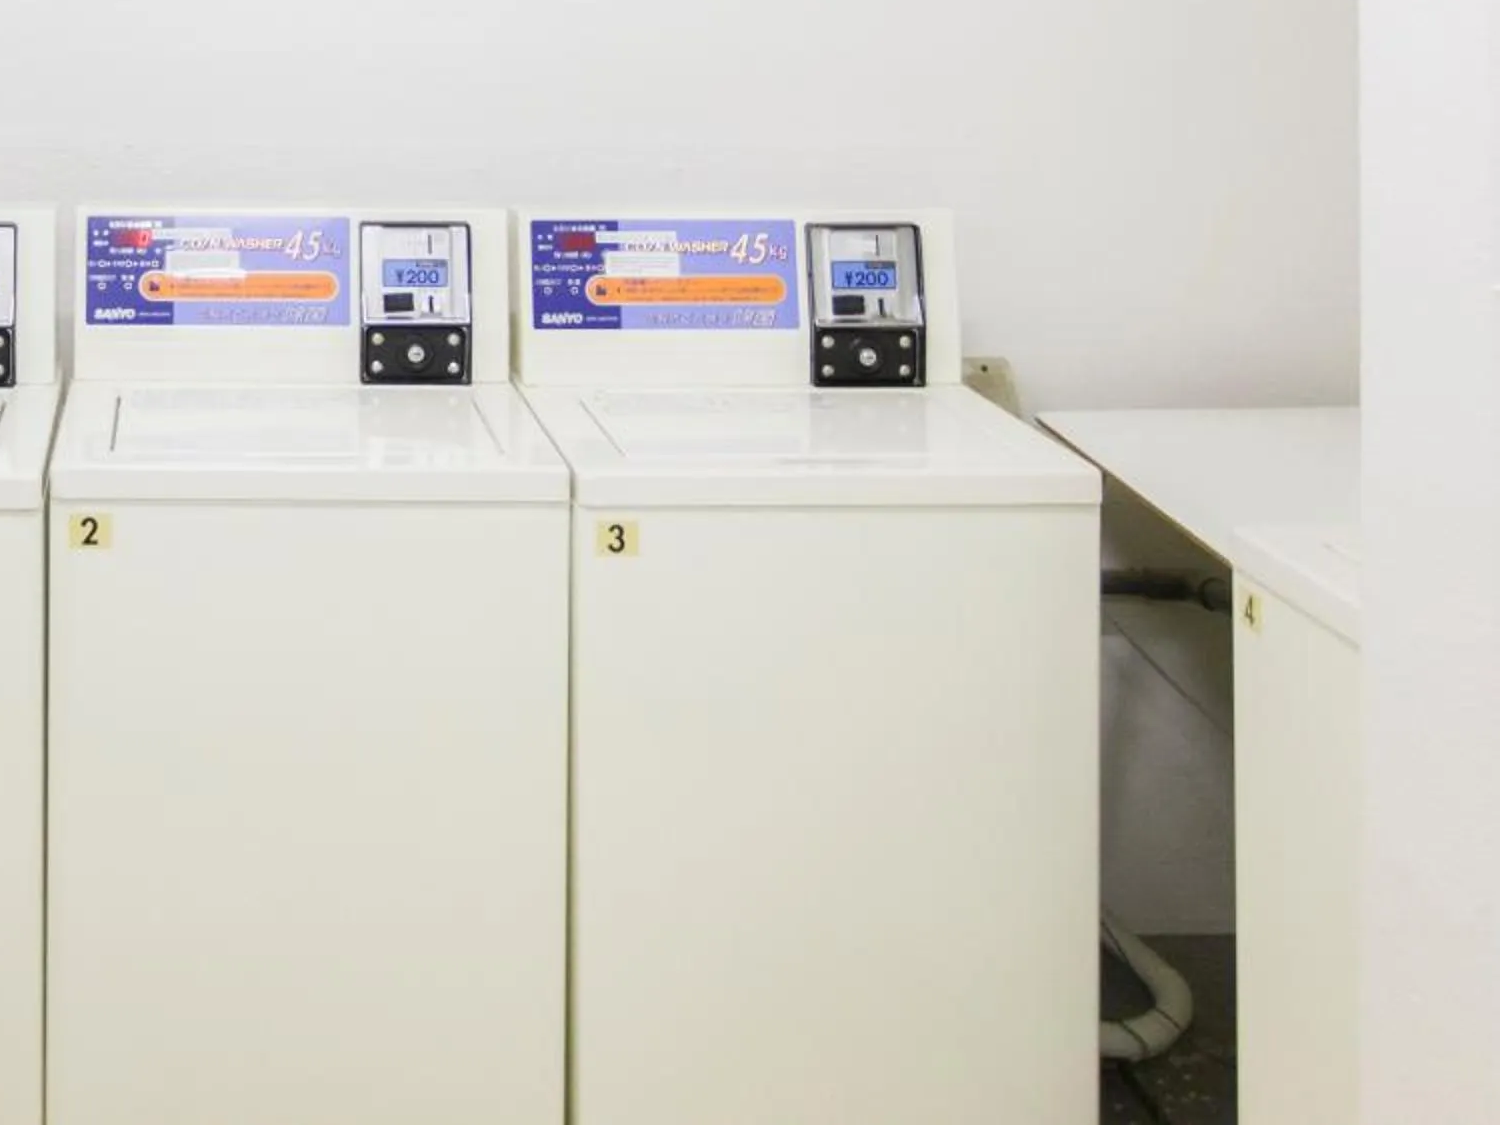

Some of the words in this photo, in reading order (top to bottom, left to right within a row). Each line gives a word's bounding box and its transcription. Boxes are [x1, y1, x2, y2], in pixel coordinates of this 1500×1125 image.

[844, 269, 889, 287] ¥200
[80, 516, 99, 546] 2
[607, 524, 625, 554] 3
[1243, 594, 1255, 625] 4
